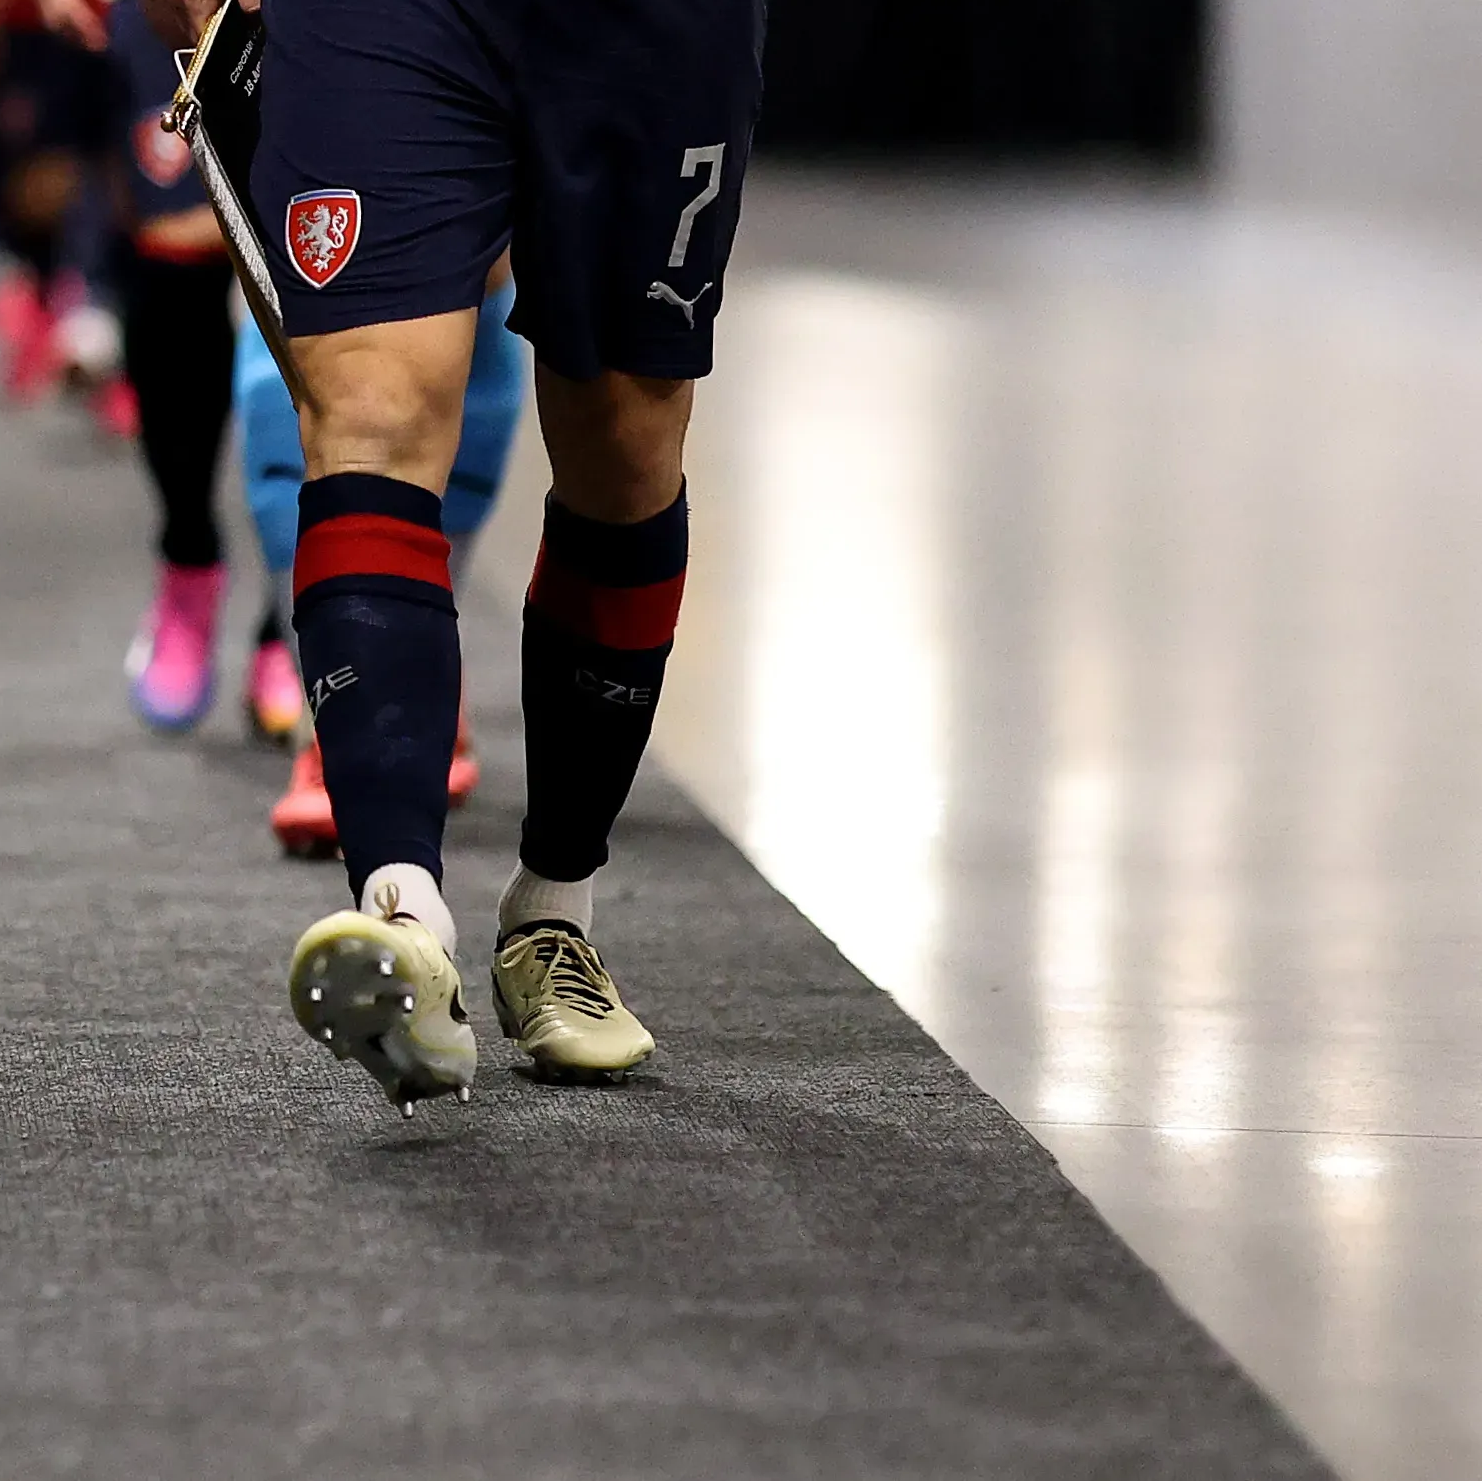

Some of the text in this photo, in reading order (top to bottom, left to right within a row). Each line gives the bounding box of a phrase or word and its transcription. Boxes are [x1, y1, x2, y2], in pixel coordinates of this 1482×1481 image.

[243, 78, 254, 97] 18
[668, 143, 726, 267] 7
[576, 668, 651, 705] CZE
